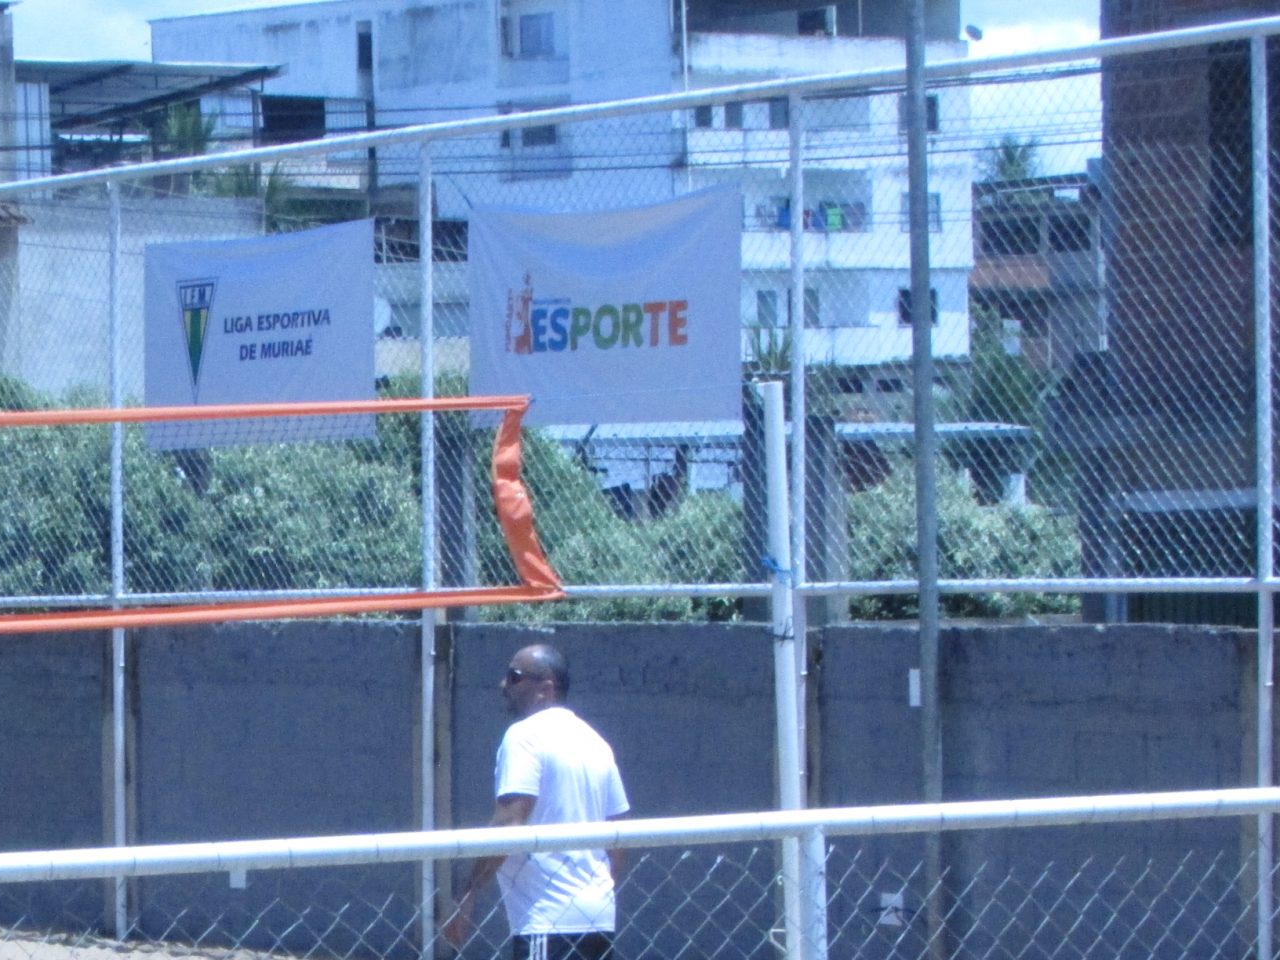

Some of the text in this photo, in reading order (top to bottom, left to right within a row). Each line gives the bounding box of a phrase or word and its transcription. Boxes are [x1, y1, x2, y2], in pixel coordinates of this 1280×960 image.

[224, 308, 331, 334] LIGA ESPORTIVA
[531, 300, 688, 353] ESPORTE
[239, 334, 313, 361] DE MURIAÉ
